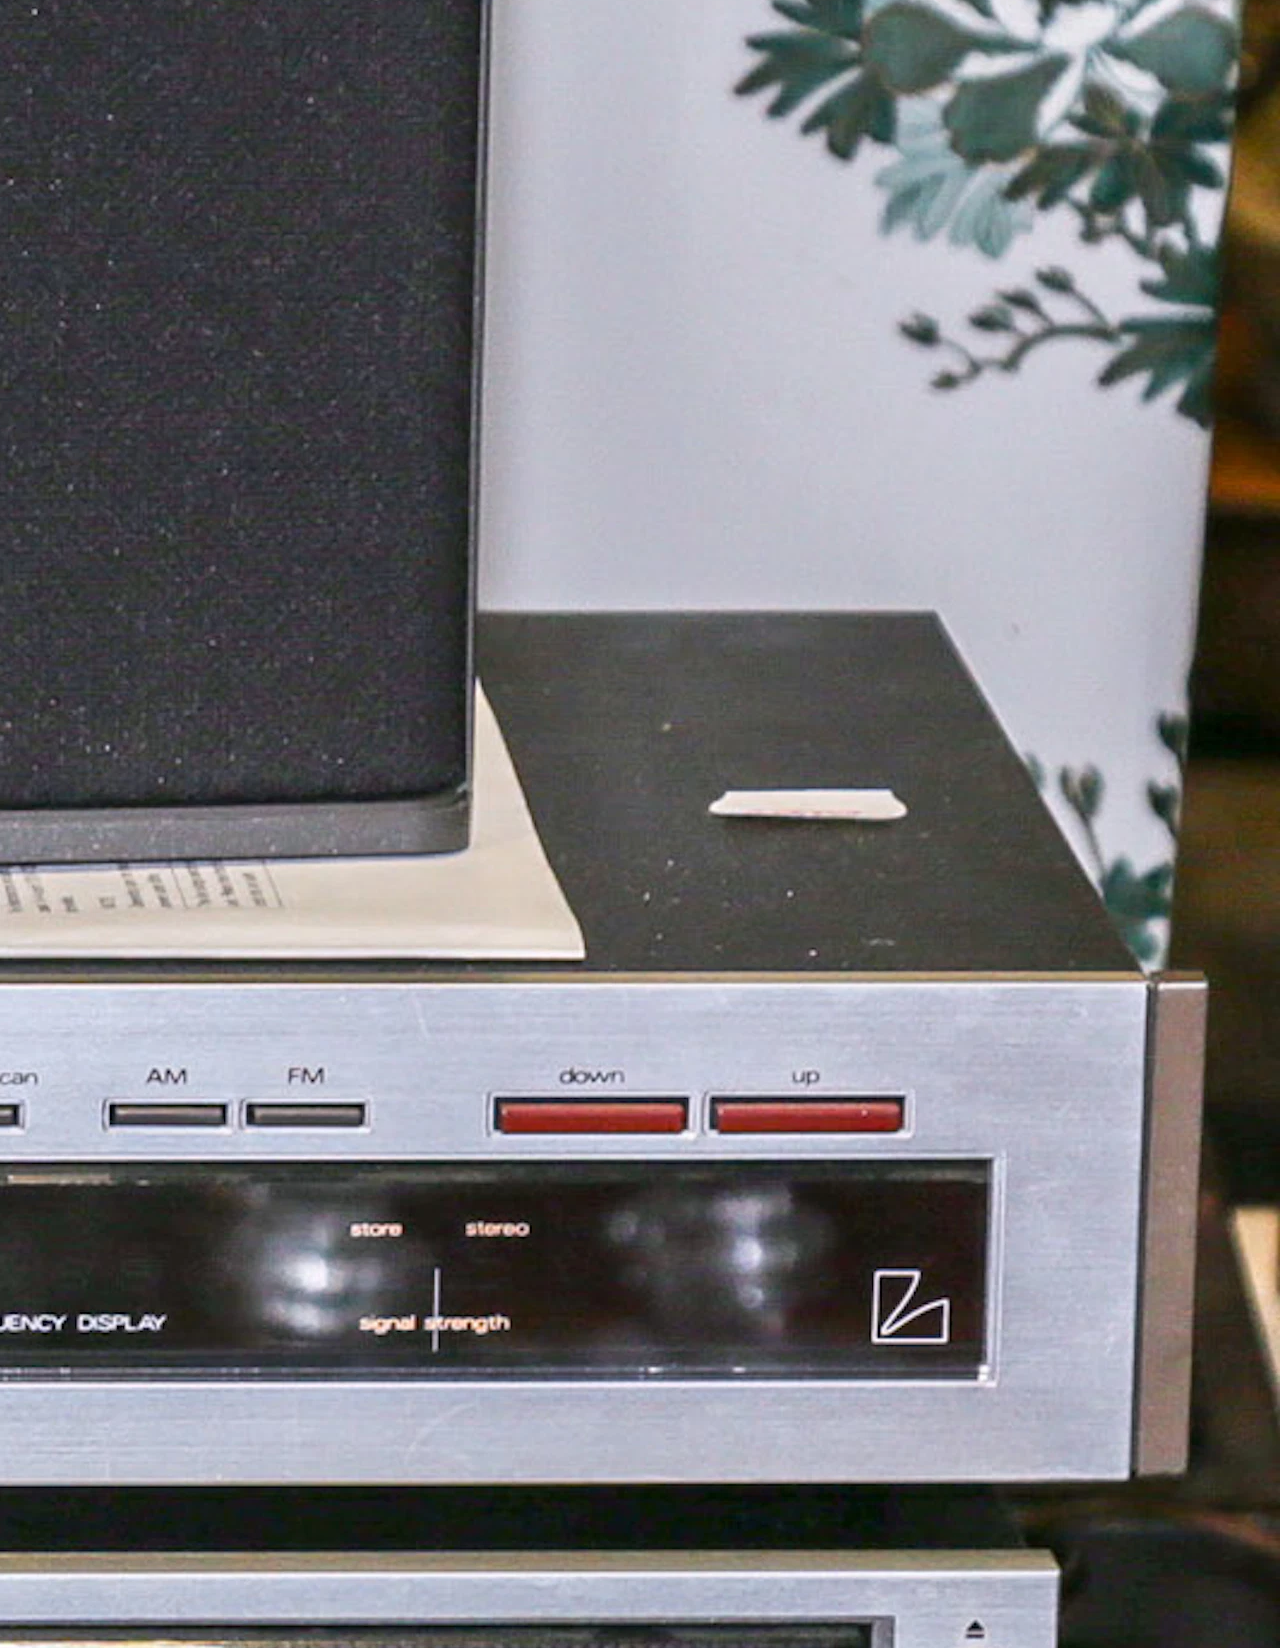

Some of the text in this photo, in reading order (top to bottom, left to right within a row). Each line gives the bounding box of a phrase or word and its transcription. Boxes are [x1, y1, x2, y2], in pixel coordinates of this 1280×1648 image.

[146, 1068, 187, 1085] AM
[287, 1067, 325, 1084] FM
[559, 1067, 625, 1085] down
[792, 1070, 821, 1086] up
[350, 1222, 403, 1238] store
[465, 1221, 530, 1237] stereo
[76, 1313, 167, 1332] DISPLAY
[359, 1314, 510, 1335] signal strength
